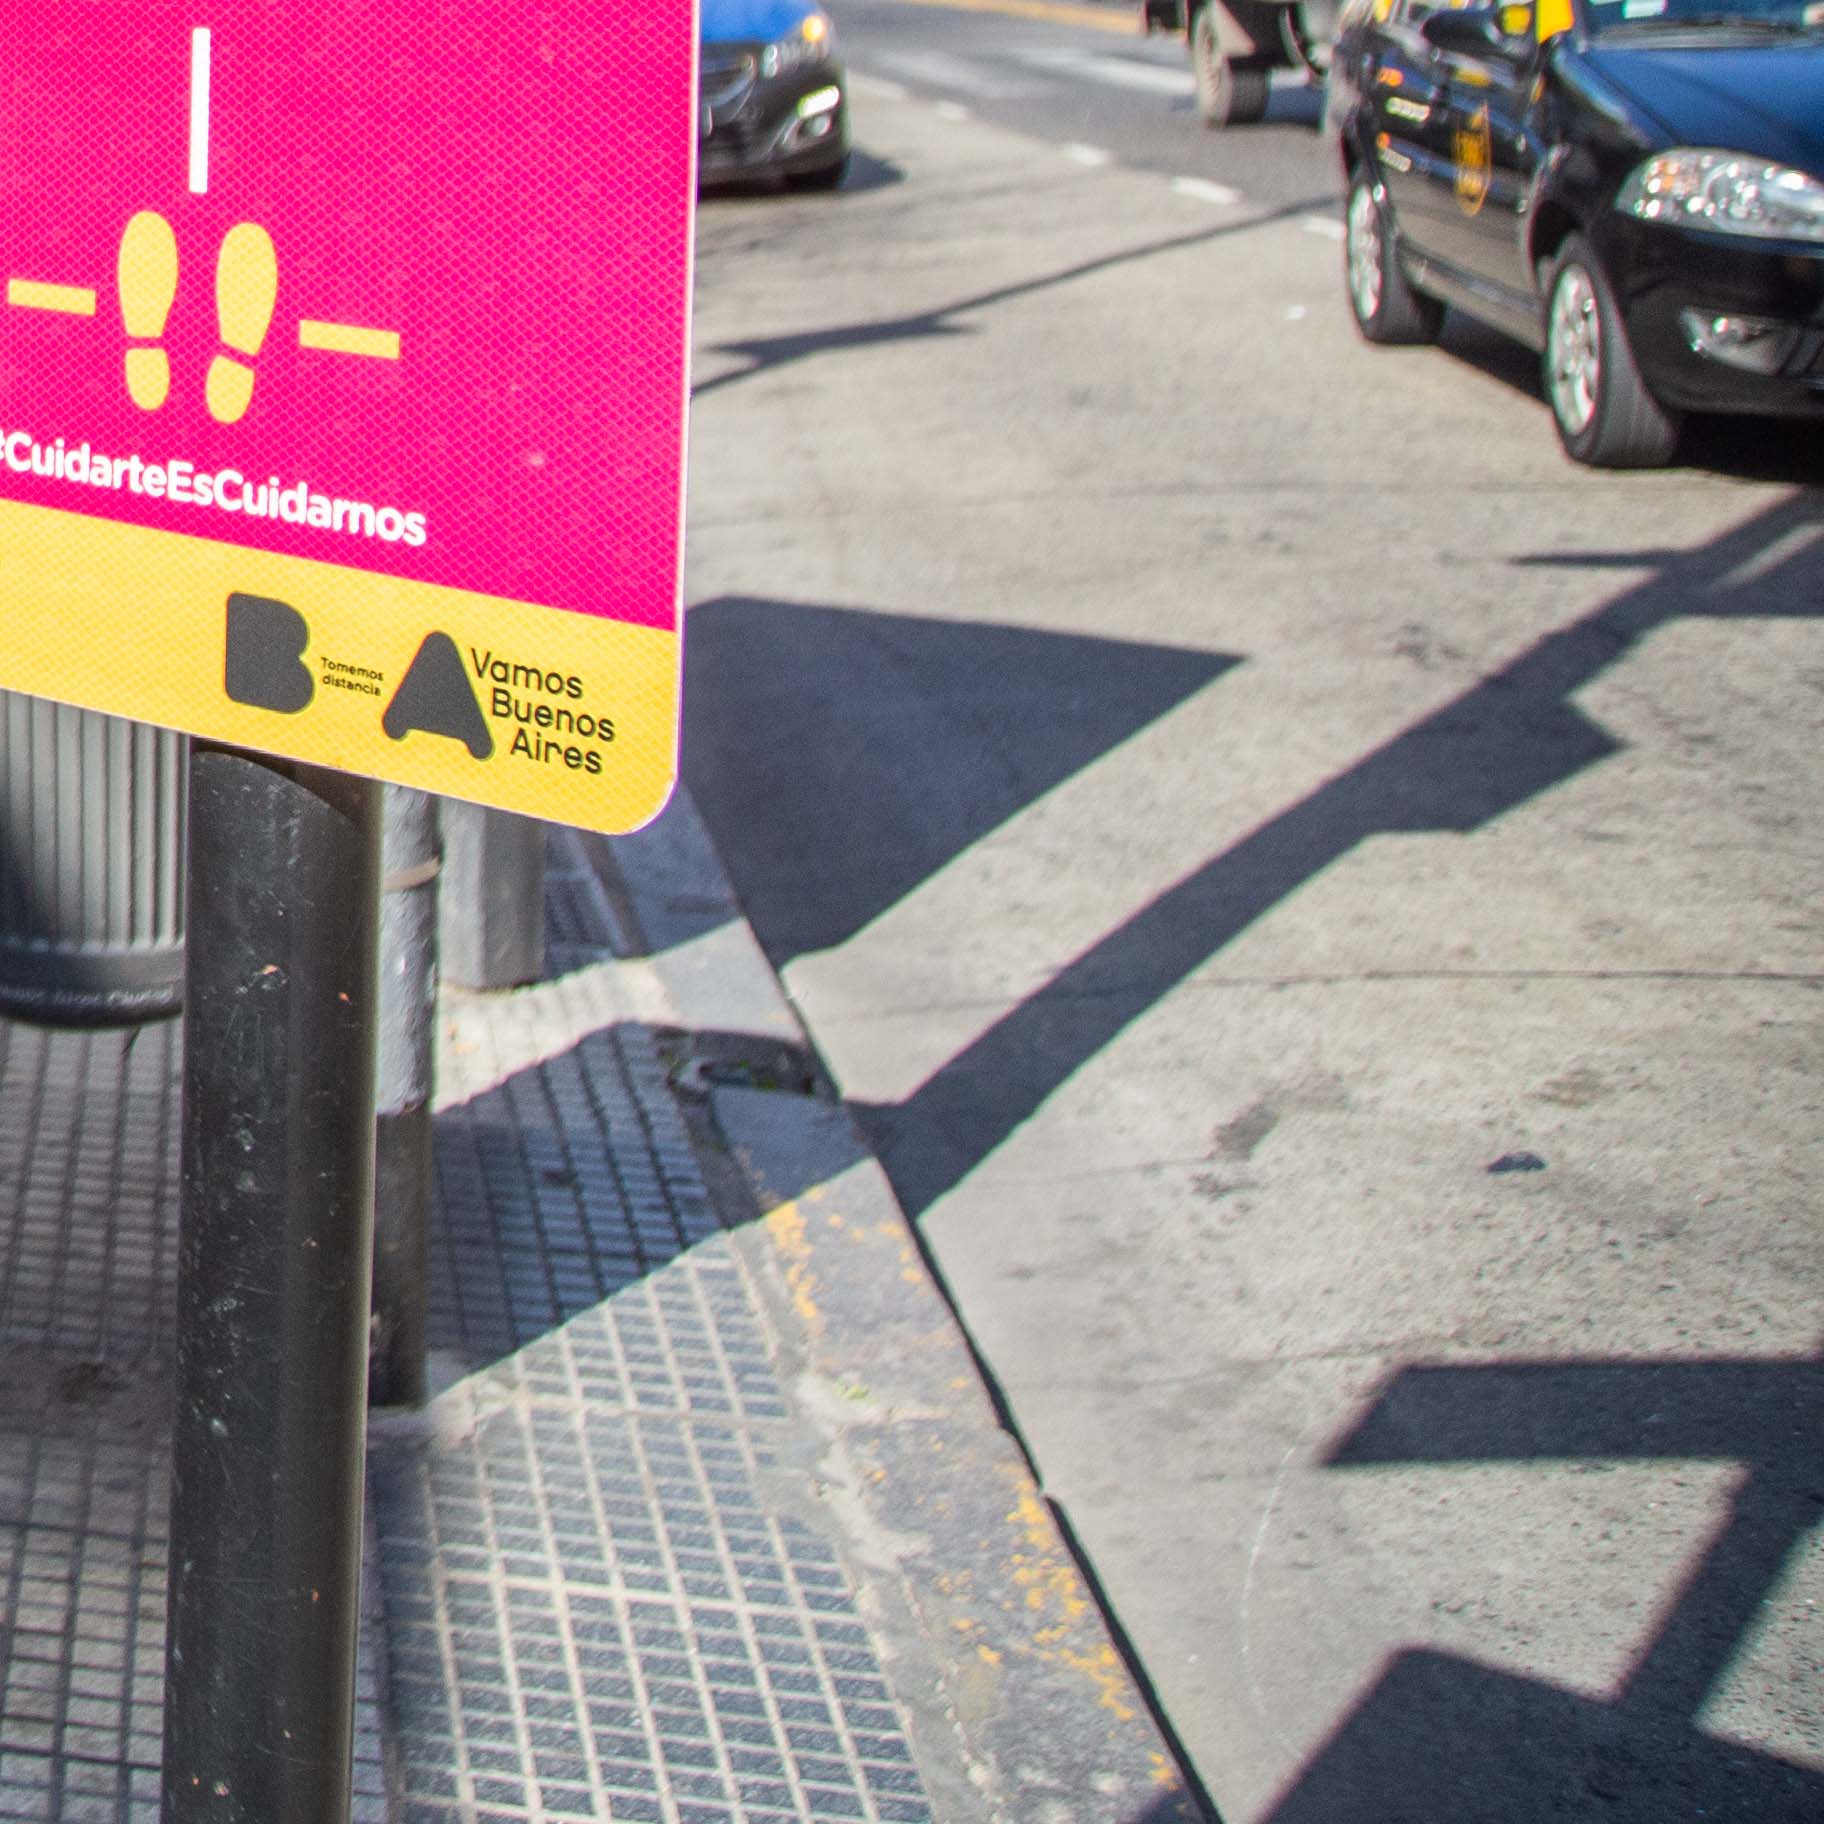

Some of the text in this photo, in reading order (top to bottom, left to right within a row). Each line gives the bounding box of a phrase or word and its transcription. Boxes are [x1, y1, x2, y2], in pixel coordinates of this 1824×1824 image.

[320, 656, 385, 682] Tomemos
[321, 673, 382, 697] distancia
[472, 648, 582, 698] Vamos
[493, 688, 614, 741] Buenos
[511, 728, 601, 774] Aires
